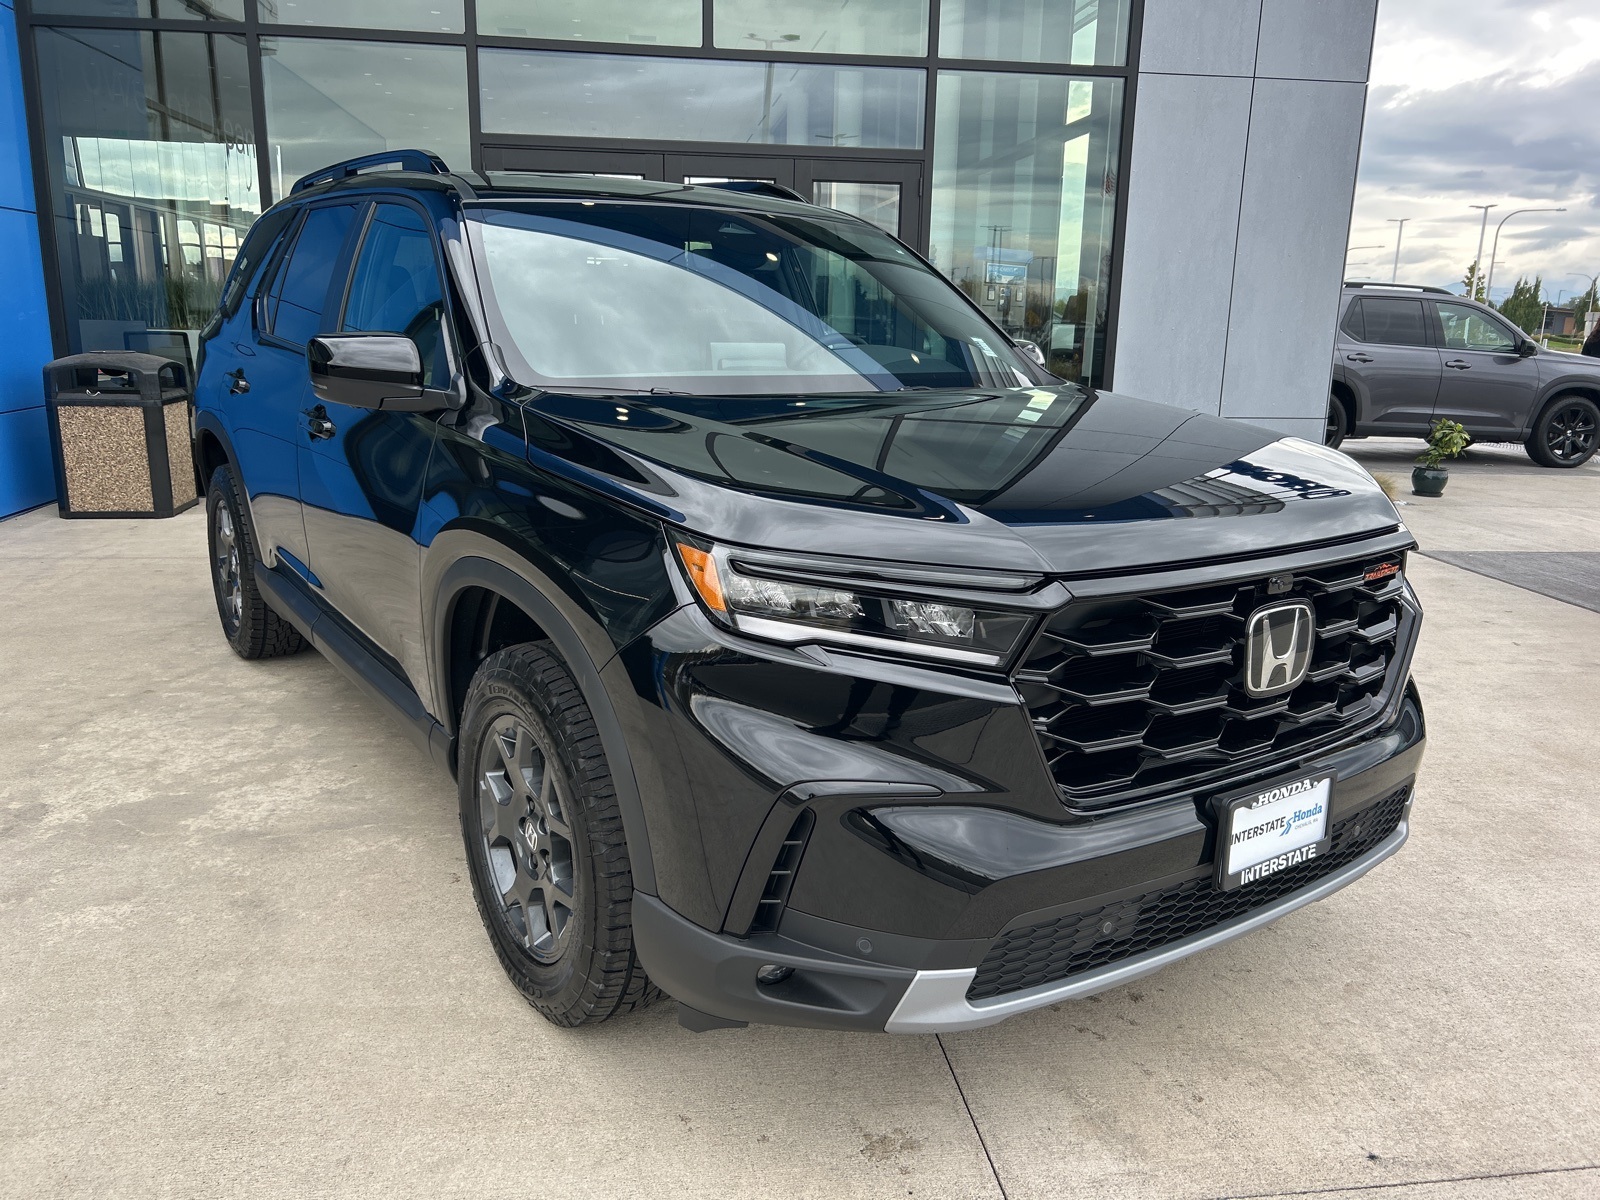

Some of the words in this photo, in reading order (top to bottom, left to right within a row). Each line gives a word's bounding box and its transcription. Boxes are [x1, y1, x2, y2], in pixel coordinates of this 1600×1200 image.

[1257, 779, 1312, 807] HONDA
[1230, 816, 1286, 845] INTERSTATE
[1292, 803, 1322, 823] Honda
[1240, 843, 1317, 886] INTERSTATE
